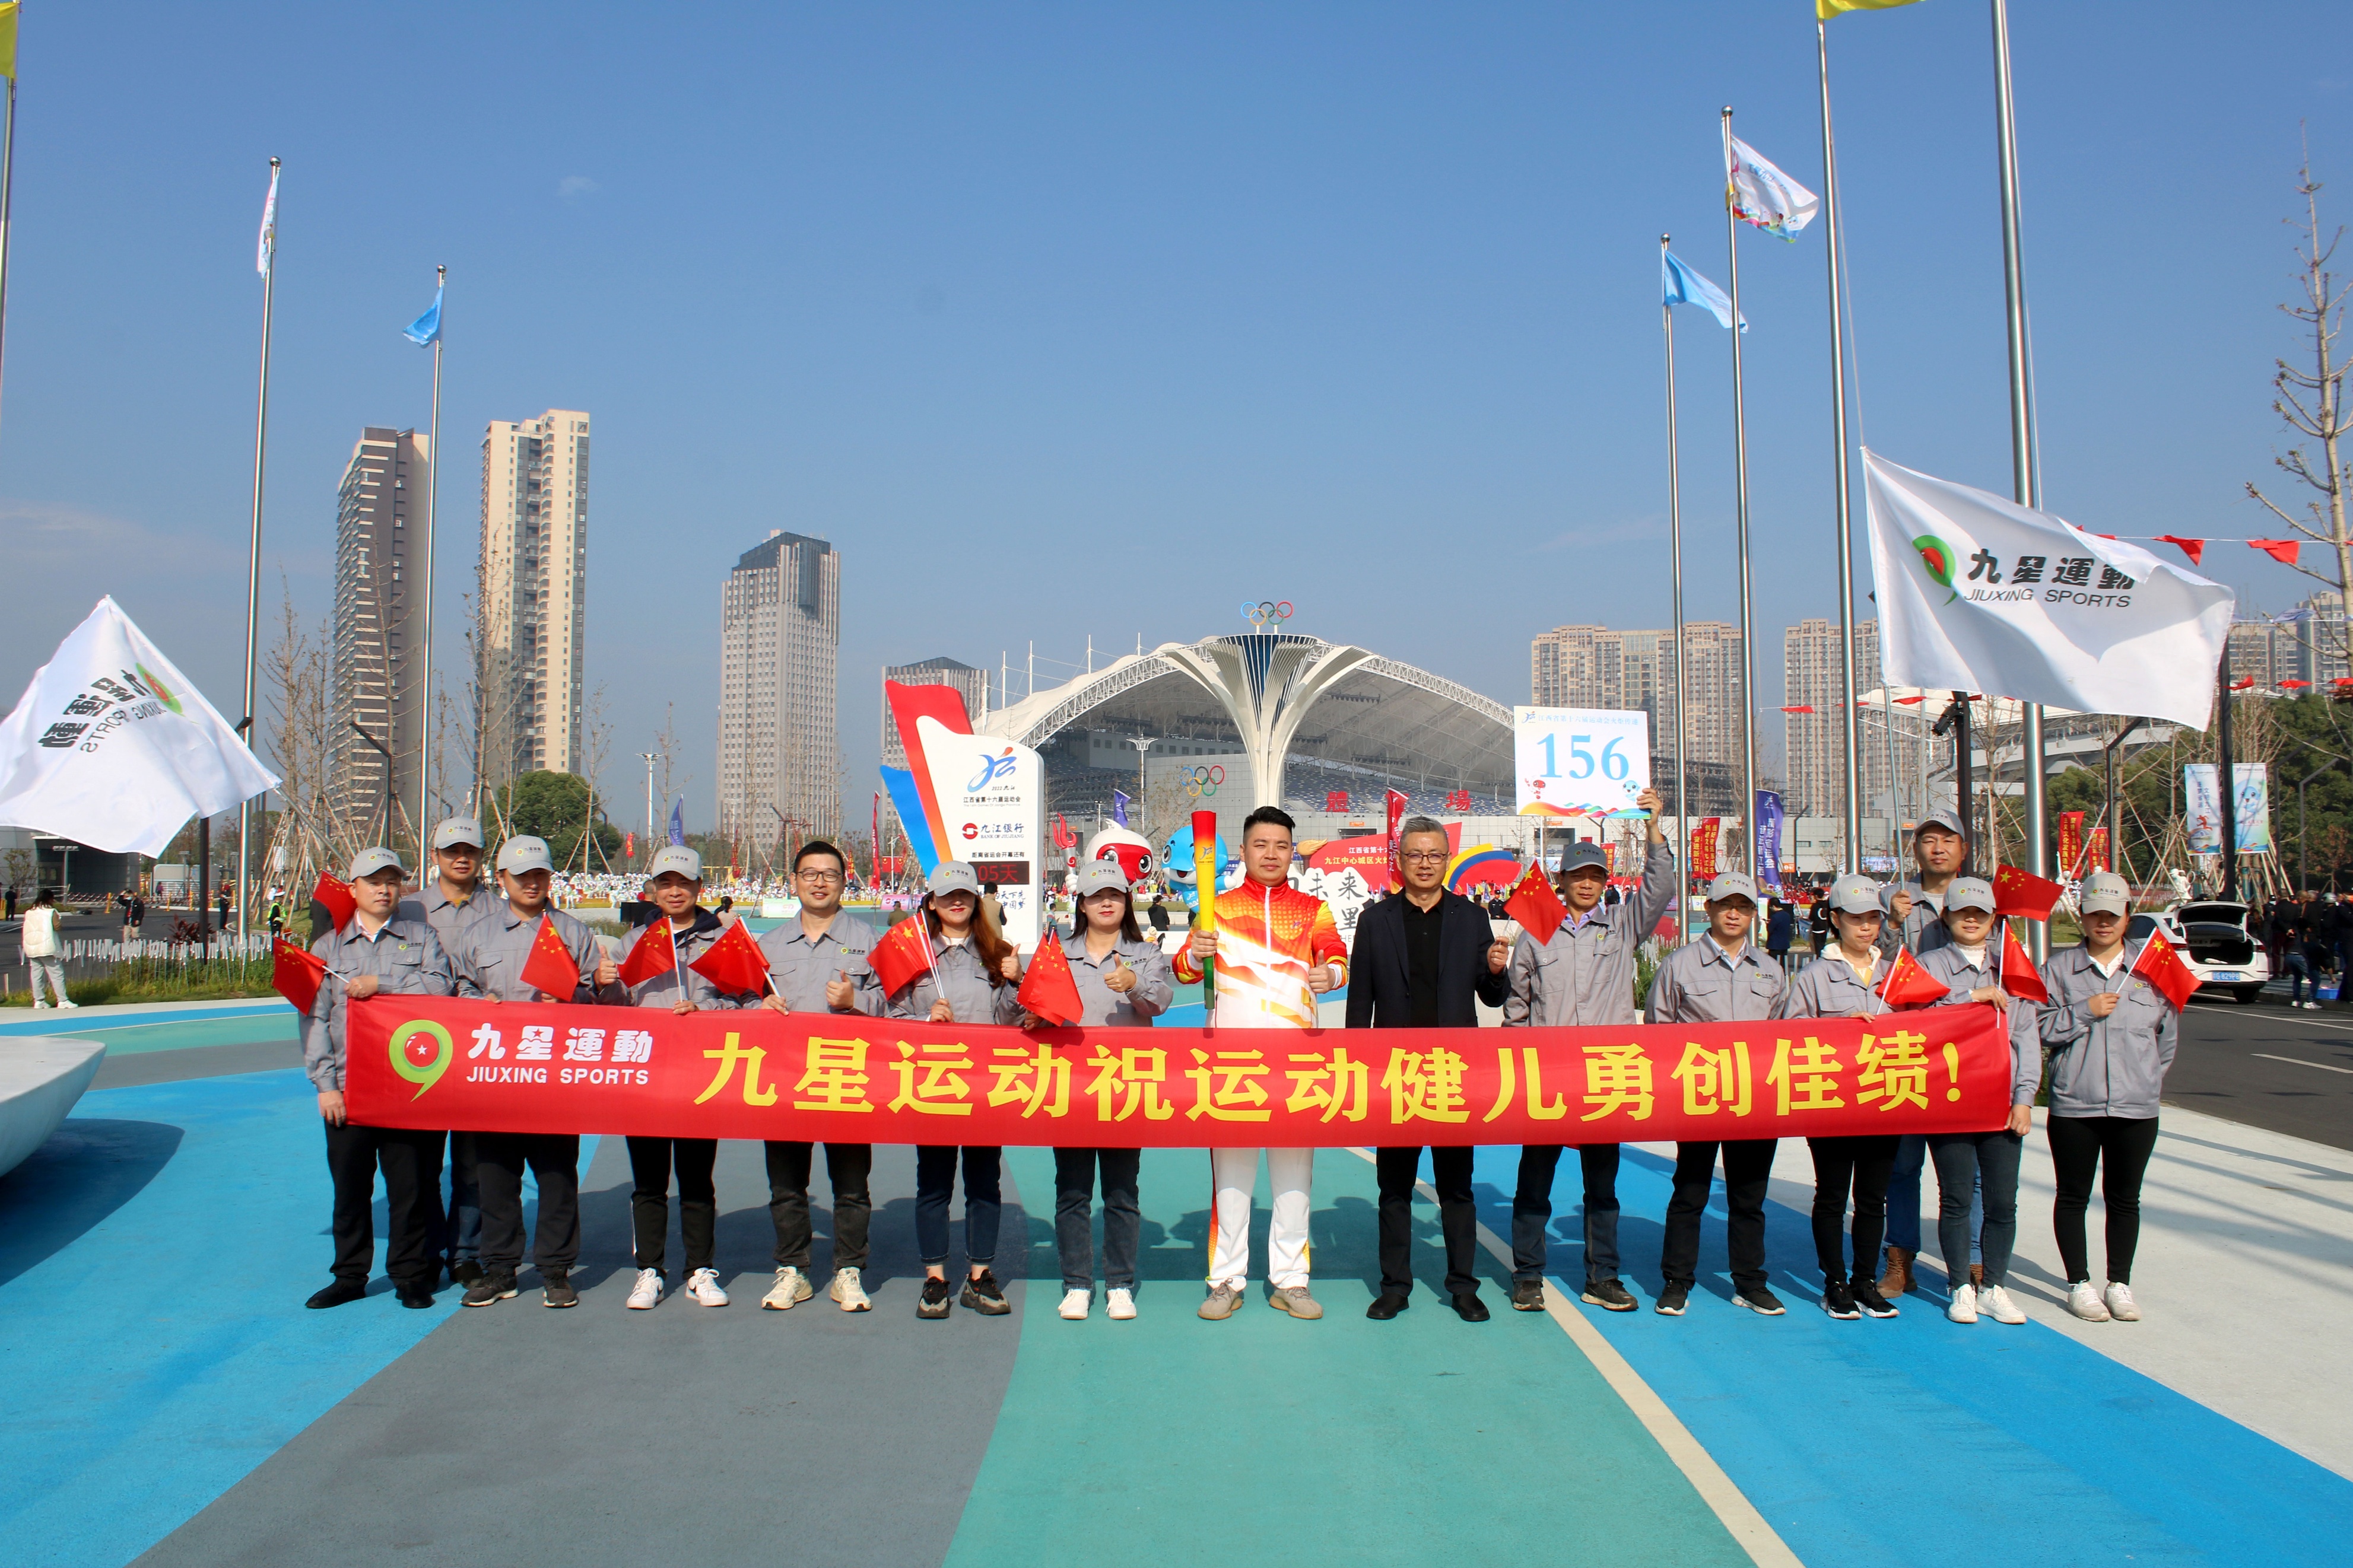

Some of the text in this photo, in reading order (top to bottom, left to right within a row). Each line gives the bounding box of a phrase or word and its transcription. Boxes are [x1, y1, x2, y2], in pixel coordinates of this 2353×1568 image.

[1968, 548, 2135, 590] 九星運動
[1964, 587, 2131, 608] JIUXING SPORTS
[1538, 714, 1639, 726] 江西省第十六届运动会火炬传递
[1536, 733, 1629, 780] 156
[980, 823, 1024, 833] 九江银行
[467, 1022, 653, 1063] 九星運動
[466, 1066, 649, 1086] JIUXING SPORTS
